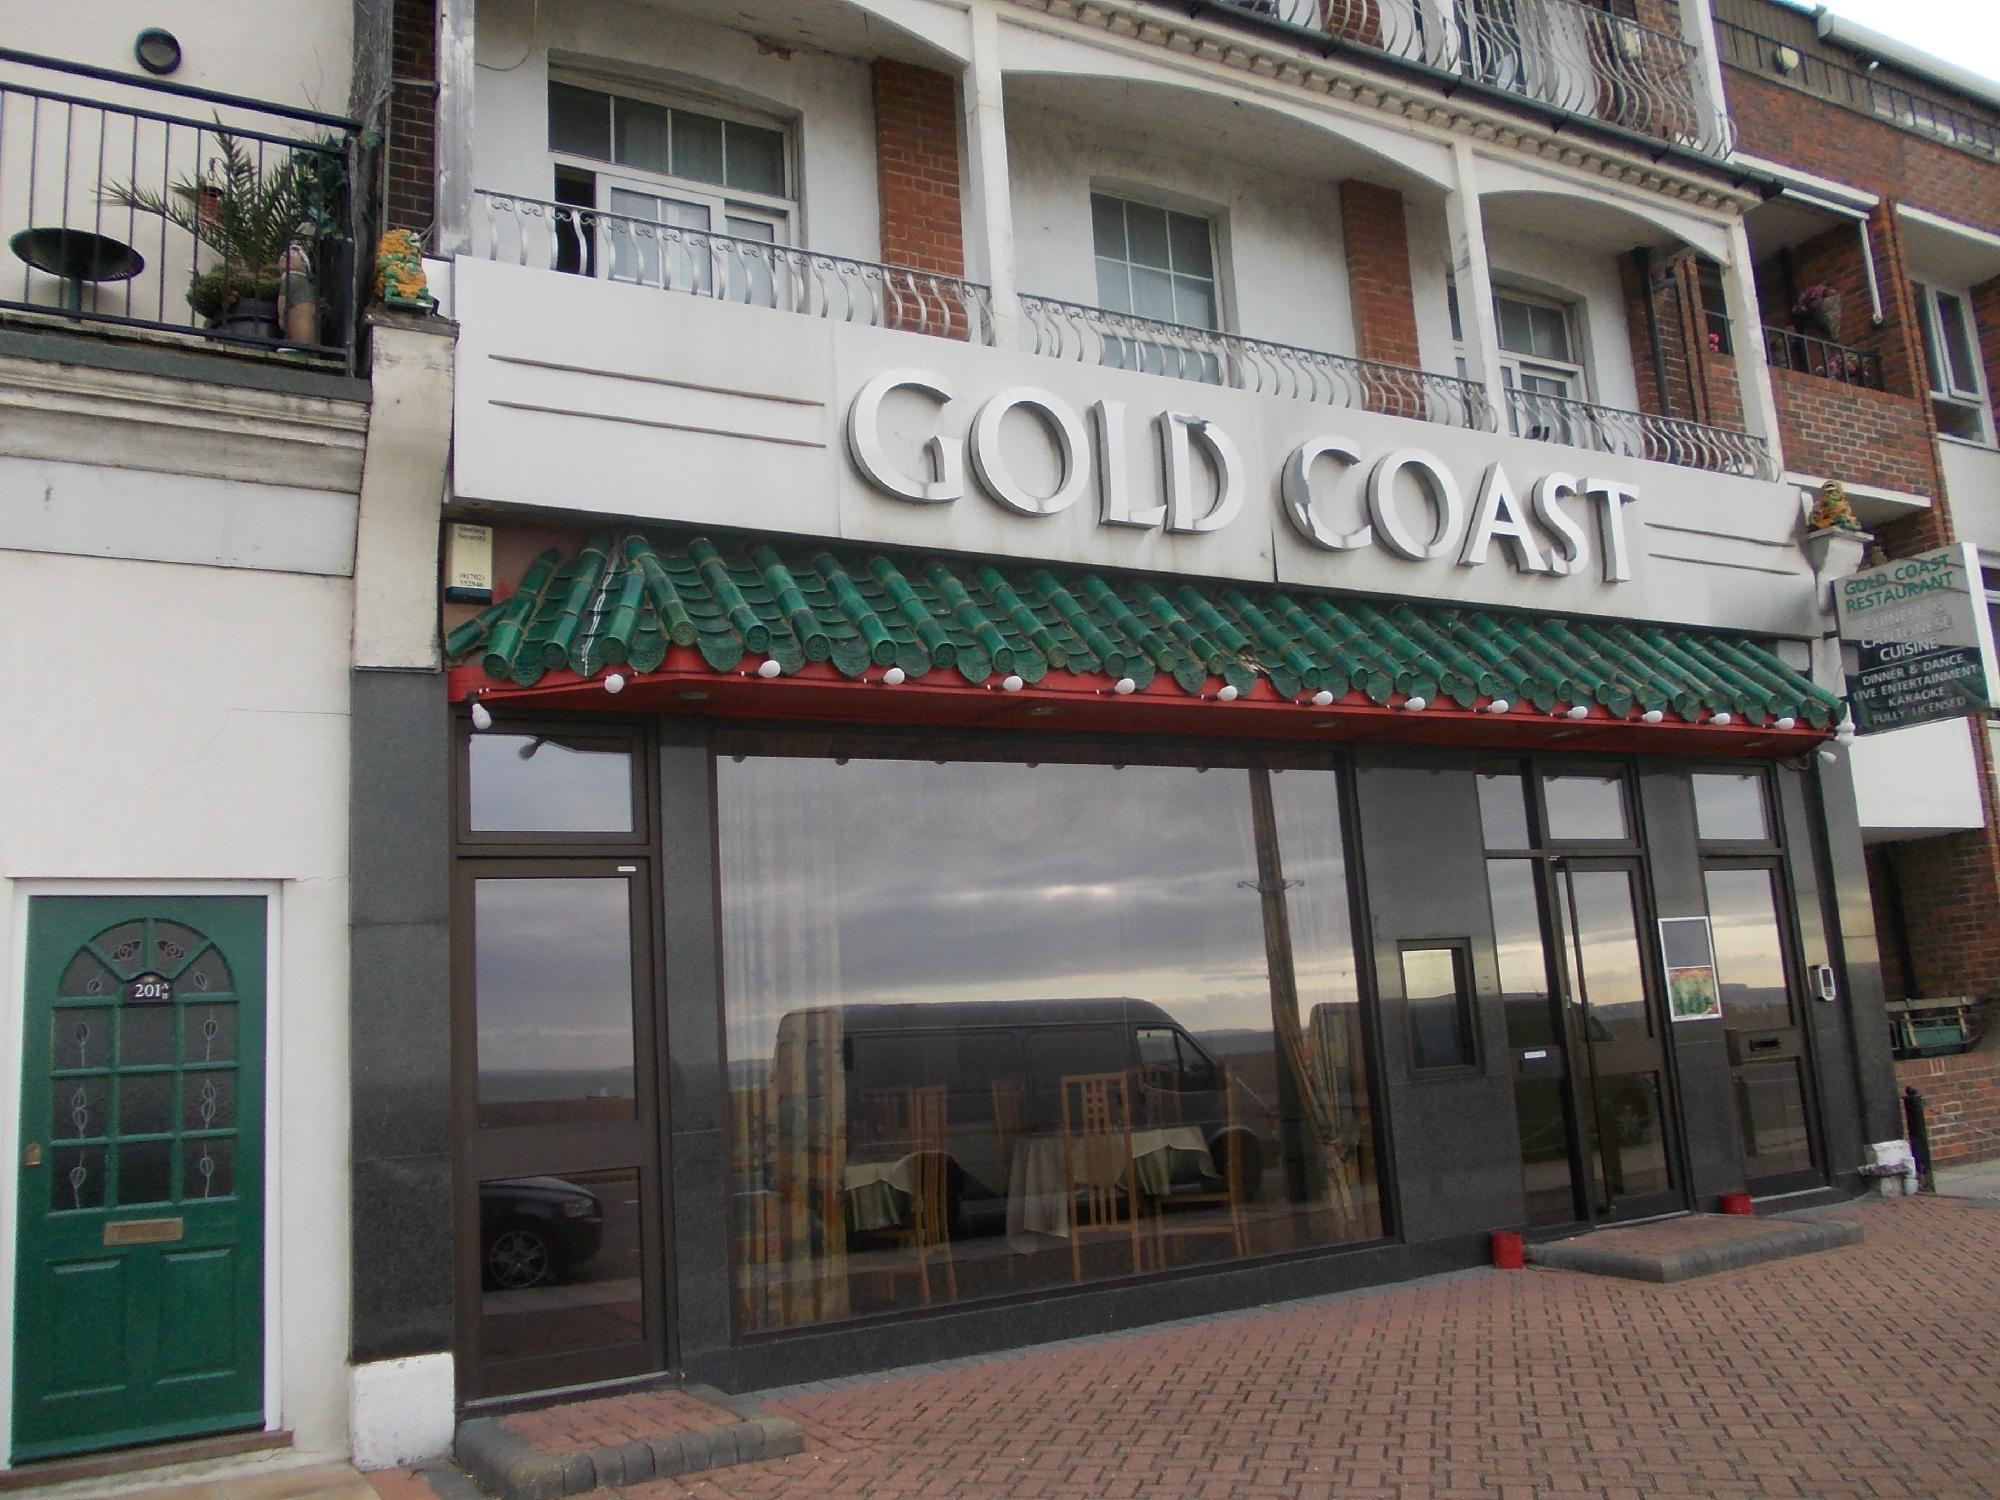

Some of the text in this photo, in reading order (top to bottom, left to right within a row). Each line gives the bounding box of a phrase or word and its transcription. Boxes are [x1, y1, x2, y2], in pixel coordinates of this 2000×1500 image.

[847, 368, 1640, 583] GOLD COAST
[1845, 554, 1950, 595] GOLD COAST
[1846, 571, 1954, 612] RESTAURANT
[1861, 616, 1951, 648] CANTONESE
[1864, 603, 1922, 632] CHINESE
[1879, 637, 1939, 661] CUISINE
[1853, 664, 1978, 702] LIVE ENTERTAINMENT
[1862, 653, 1964, 686] DINNER & DANCE
[1872, 696, 1967, 724] FULLY LICENSED
[1888, 686, 1945, 707] KARAOKE
[135, 983, 160, 997] 201
